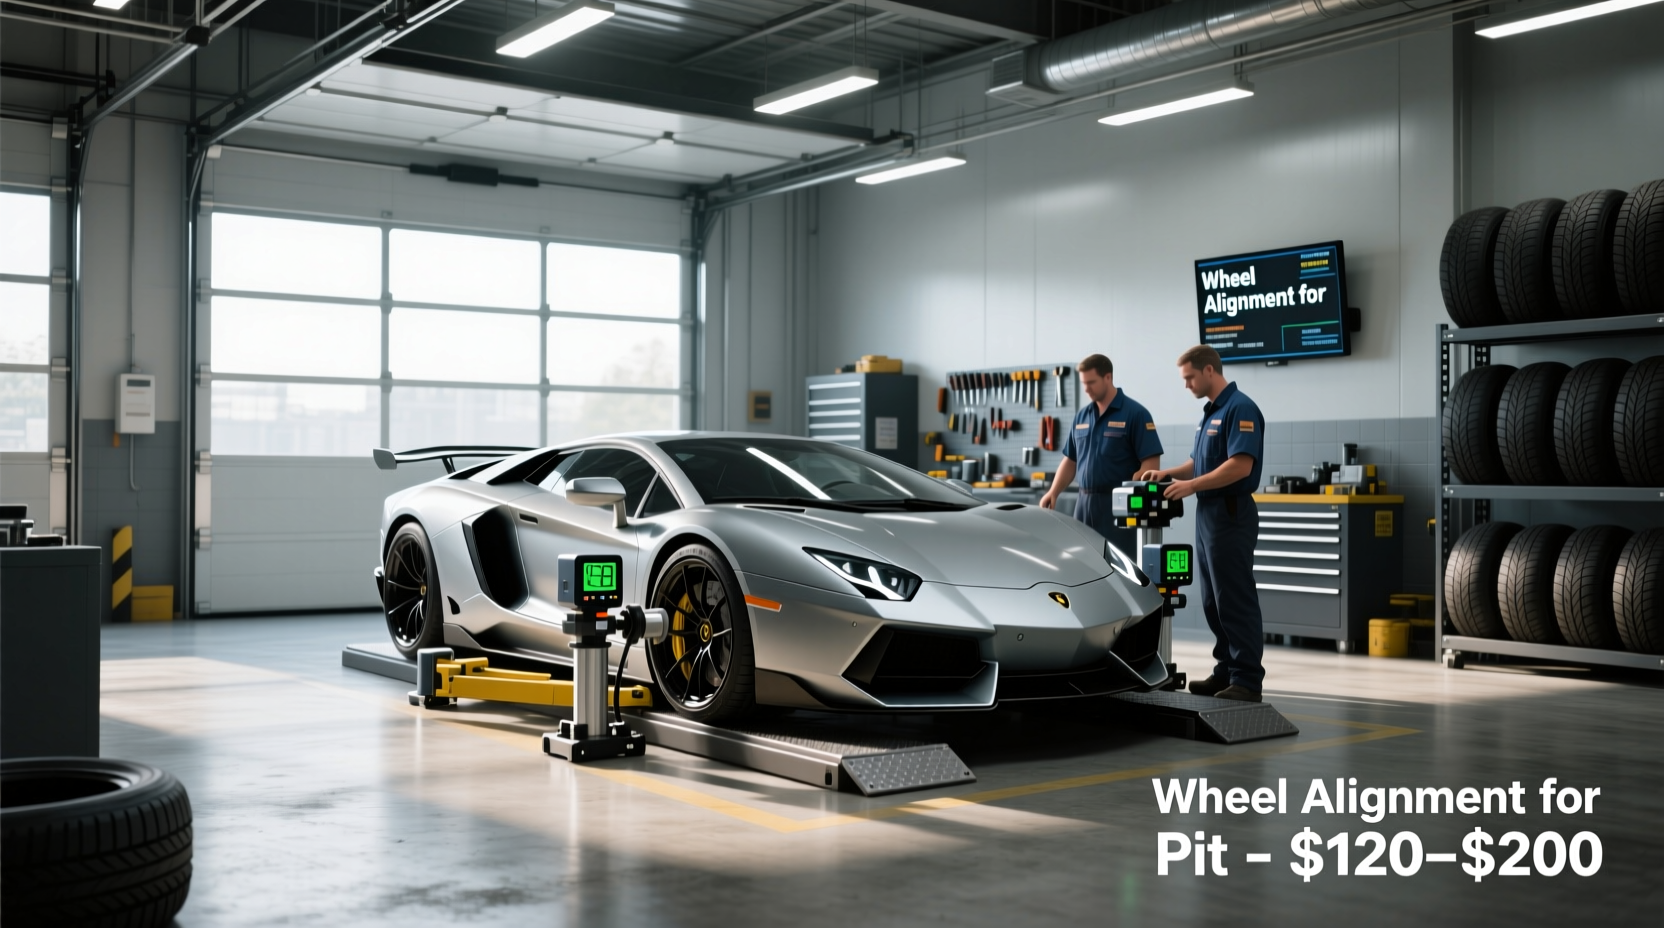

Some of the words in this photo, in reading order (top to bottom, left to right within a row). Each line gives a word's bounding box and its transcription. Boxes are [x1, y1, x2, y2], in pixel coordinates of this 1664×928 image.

[1201, 265, 1256, 290] Wheel
[1204, 286, 1296, 317] Alignment
[1299, 283, 1327, 304] for
